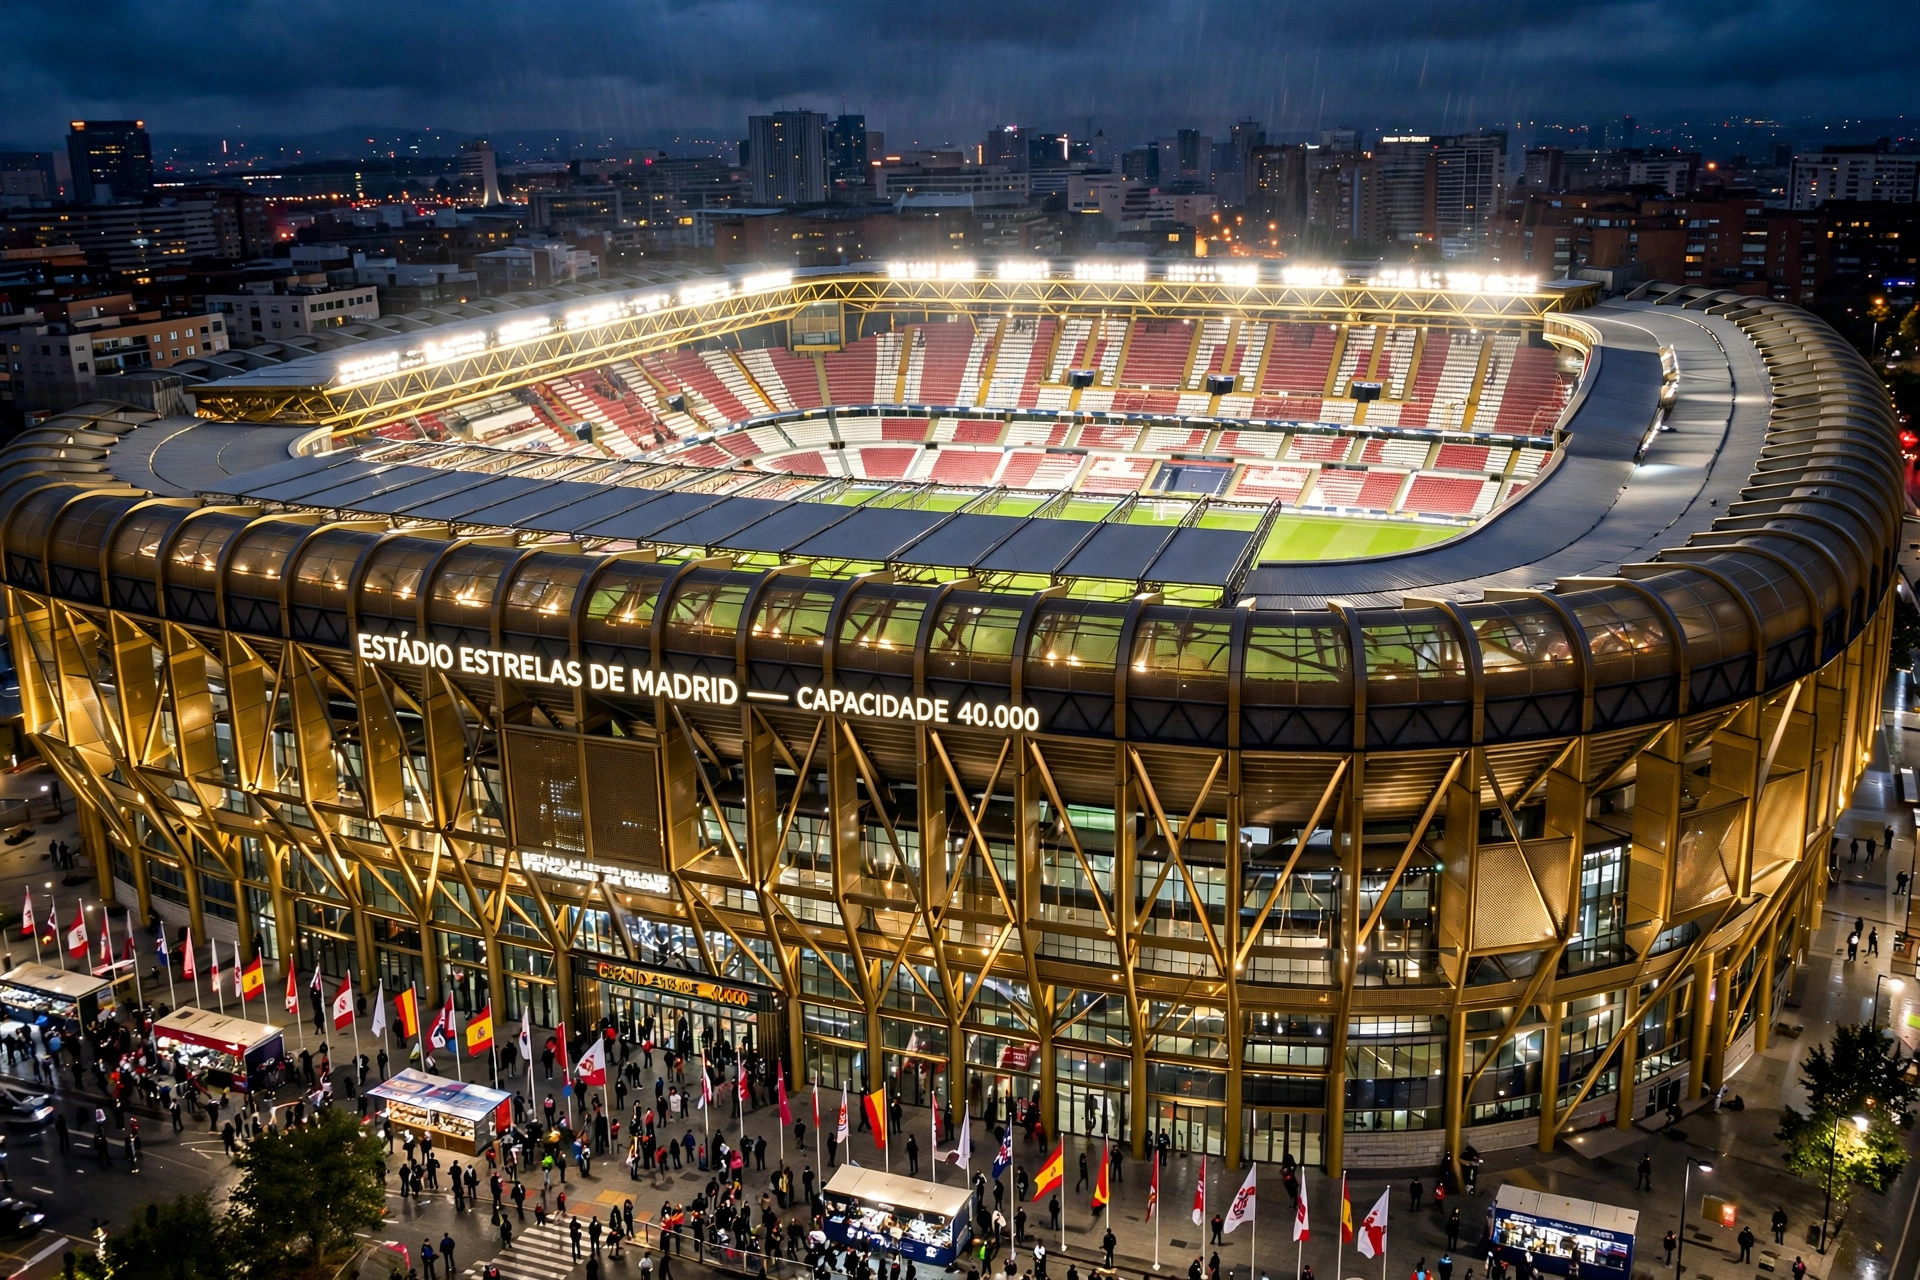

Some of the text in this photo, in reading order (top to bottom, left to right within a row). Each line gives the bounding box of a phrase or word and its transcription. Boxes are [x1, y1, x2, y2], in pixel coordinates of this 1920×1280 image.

[357, 630, 454, 670] ESTÁDIO
[459, 646, 583, 687] ESTRELAS
[589, 663, 626, 692] DE
[632, 668, 739, 705] MADRID
[797, 686, 949, 723] CAPACIDADE
[957, 701, 1040, 731] 40.000
